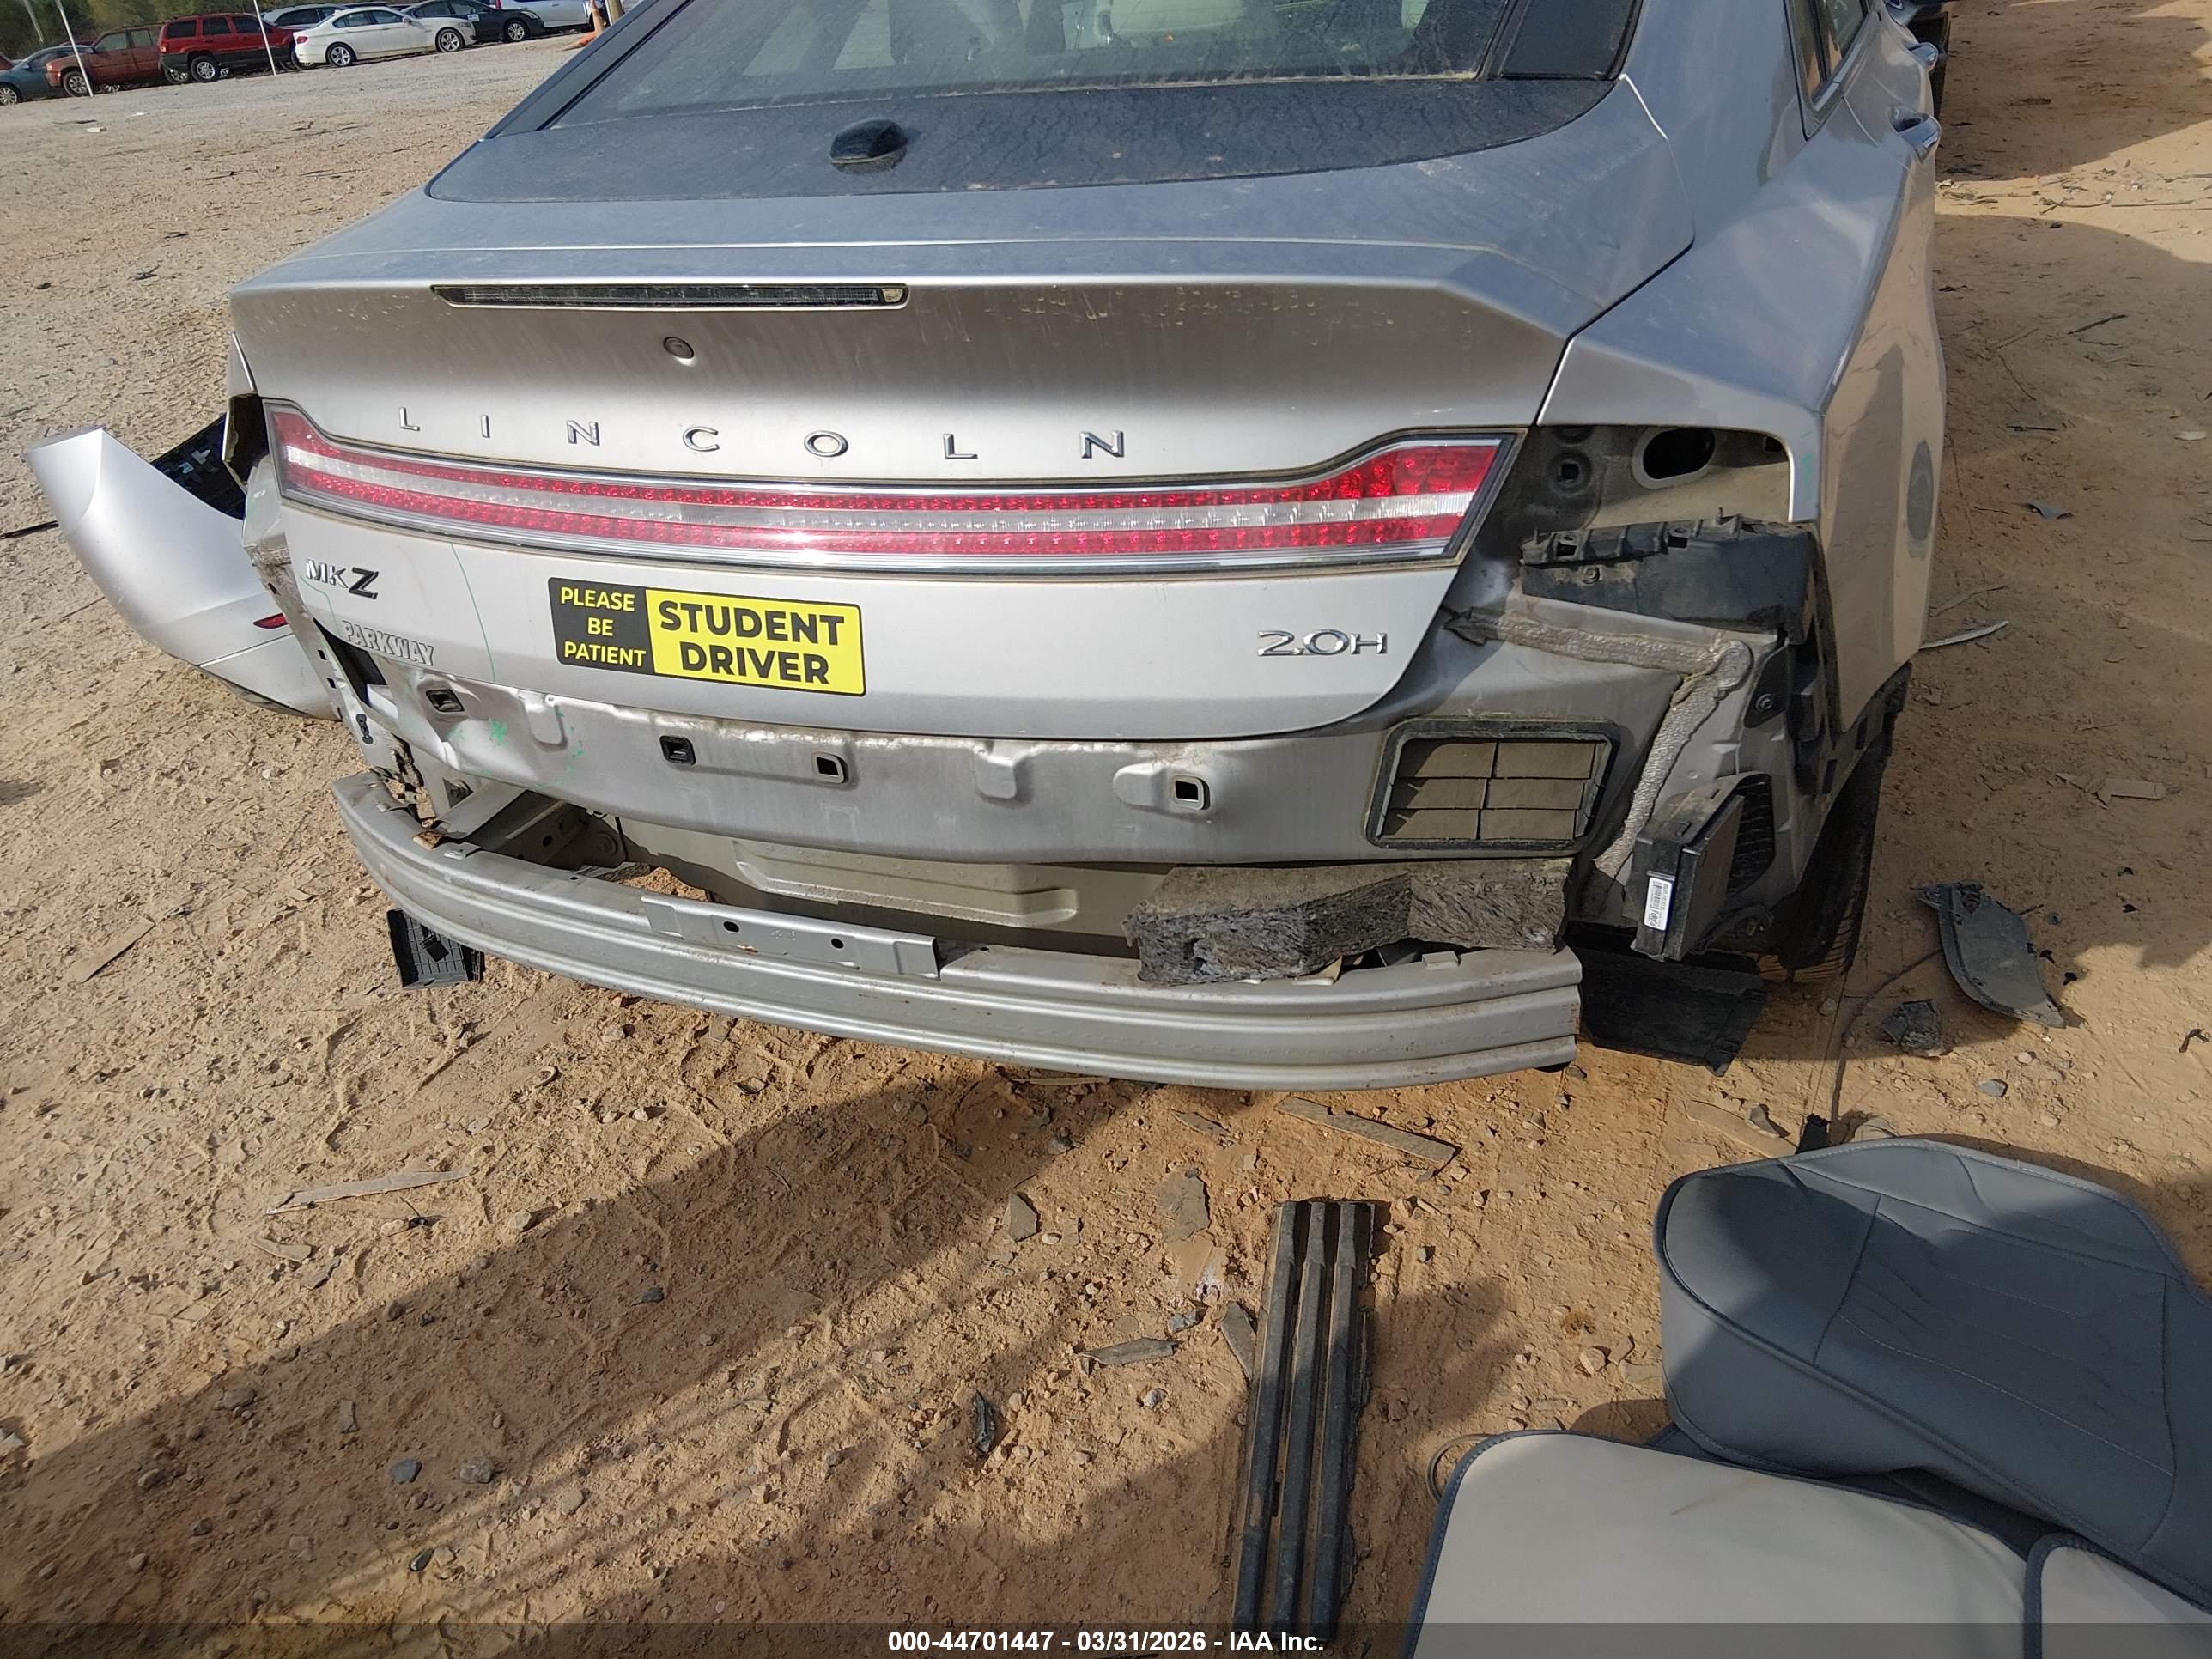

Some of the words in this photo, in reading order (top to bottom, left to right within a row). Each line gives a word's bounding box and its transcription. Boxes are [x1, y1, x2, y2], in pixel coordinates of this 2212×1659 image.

[399, 406, 1125, 459] LINCOLN
[306, 558, 379, 599] MKZ
[561, 586, 635, 612] PLEASE
[342, 619, 434, 666] PARKWAY
[587, 617, 613, 636] BE
[659, 600, 845, 646] STUDENT
[1257, 629, 1389, 656] 2.0H
[564, 641, 646, 667] PATIENT
[679, 641, 830, 684] DRIVER
